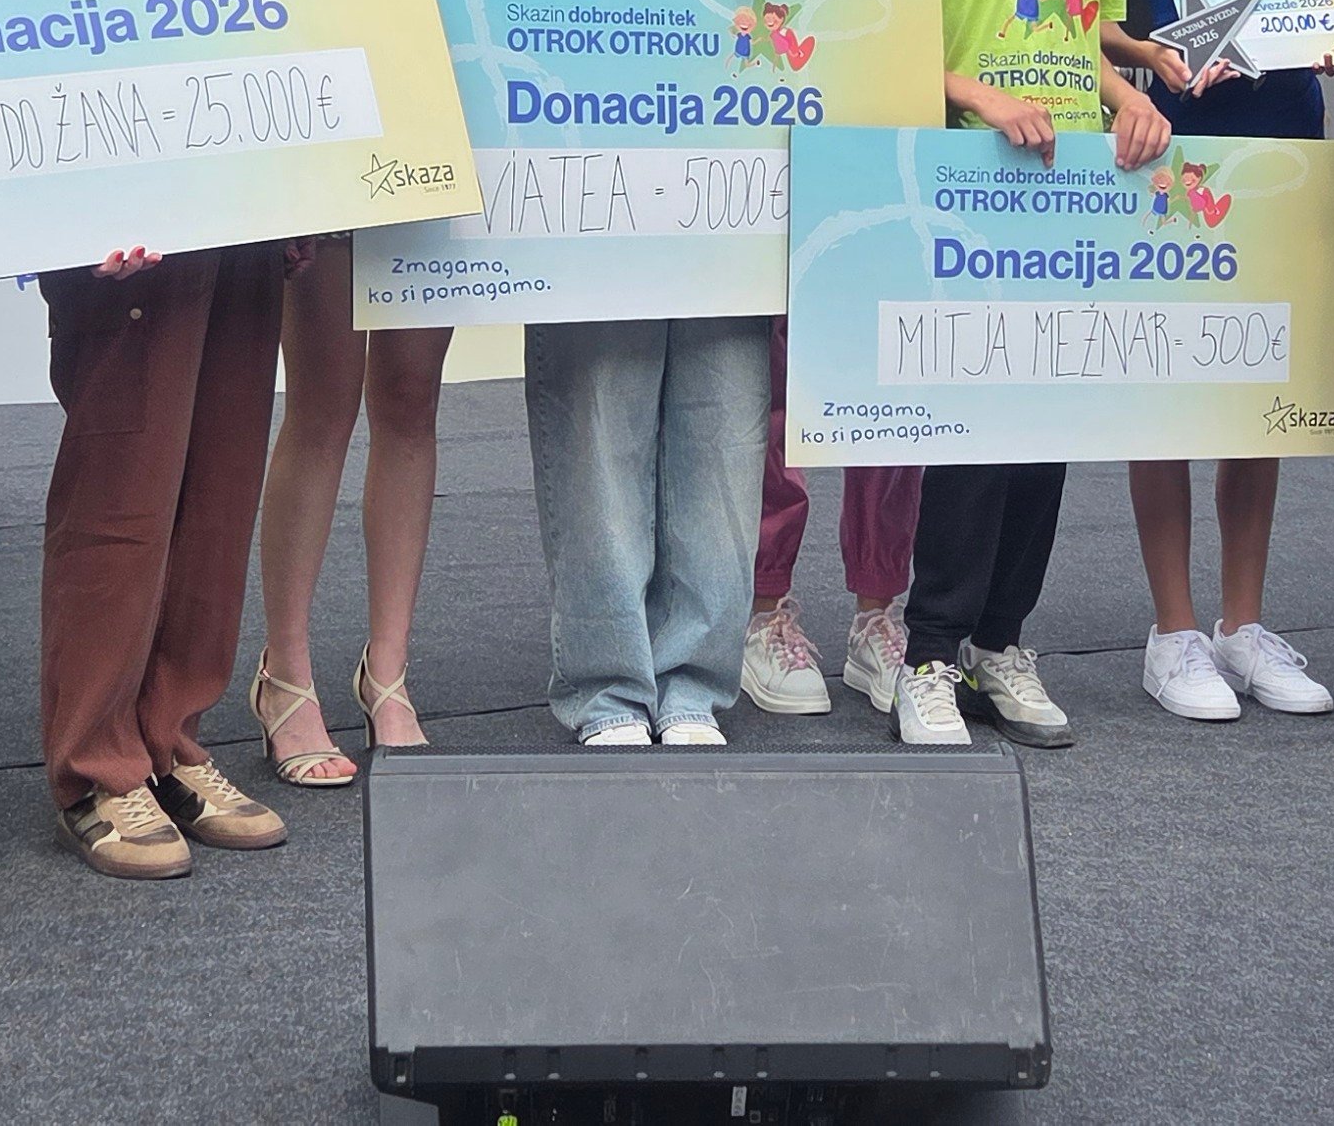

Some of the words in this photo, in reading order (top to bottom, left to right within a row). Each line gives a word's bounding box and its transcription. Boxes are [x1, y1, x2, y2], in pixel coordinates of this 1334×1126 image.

[507, 3, 565, 23] Skazin
[568, 6, 665, 26] dobrodelni
[668, 9, 696, 27] tek
[507, 28, 605, 54] OTROK
[609, 31, 720, 56] OTROKU
[1189, 30, 1219, 49] 2026
[978, 50, 1030, 68] Skazin
[979, 68, 1050, 88] OTROK
[507, 80, 704, 134] Donacija
[713, 85, 824, 127] 2026
[0, 99, 44, 171] DO
[51, 82, 161, 165] ŽANA
[394, 164, 454, 186] skaza
[936, 166, 990, 184] Skazin
[993, 167, 1086, 186] dobrodelni
[1090, 170, 1116, 186] tek
[935, 189, 1027, 213] OTROK
[1031, 190, 1137, 215] OTROKU
[391, 258, 509, 279] Zmagamo,
[934, 238, 1120, 288] Donacija
[1129, 242, 1238, 281] 2026
[368, 287, 393, 303] ko
[401, 285, 415, 302] si
[422, 279, 551, 304] pomagamo.
[823, 402, 931, 422] Zmagamo,
[801, 428, 824, 444] ko
[831, 427, 844, 443] si
[851, 423, 969, 444] pomagamo.
